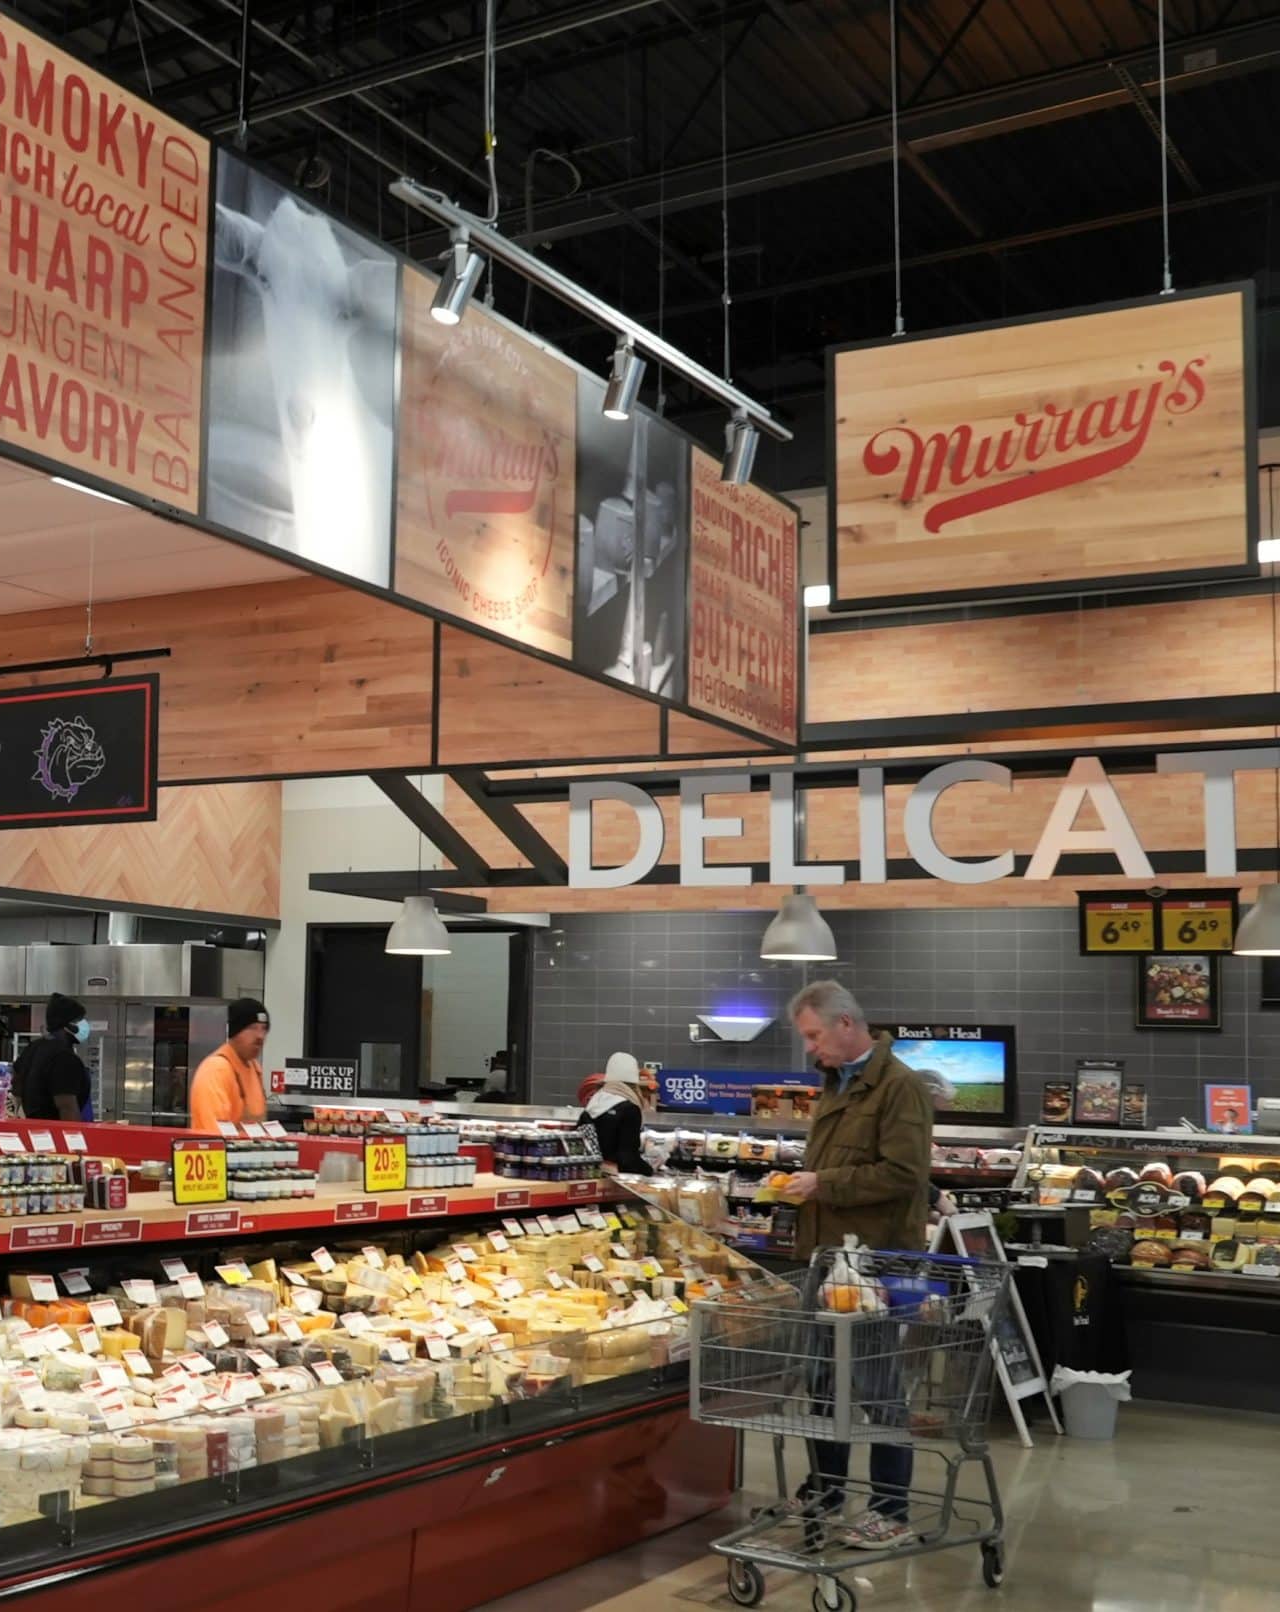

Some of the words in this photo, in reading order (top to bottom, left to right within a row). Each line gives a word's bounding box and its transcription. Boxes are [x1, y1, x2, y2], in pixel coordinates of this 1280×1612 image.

[61, 164, 151, 246] local
[152, 135, 200, 495] BALANCED
[863, 357, 1206, 534] Murray's
[436, 538, 471, 601] ICONIC
[731, 512, 782, 600] RICH
[693, 602, 783, 691] BUTTERY
[568, 748, 1280, 888] DELICAT
[310, 1065, 337, 1077] PICK
[338, 1067, 354, 1077] UP
[949, 1028, 982, 1039] Head
[310, 1077, 353, 1091] HERE
[665, 1074, 707, 1093] grab
